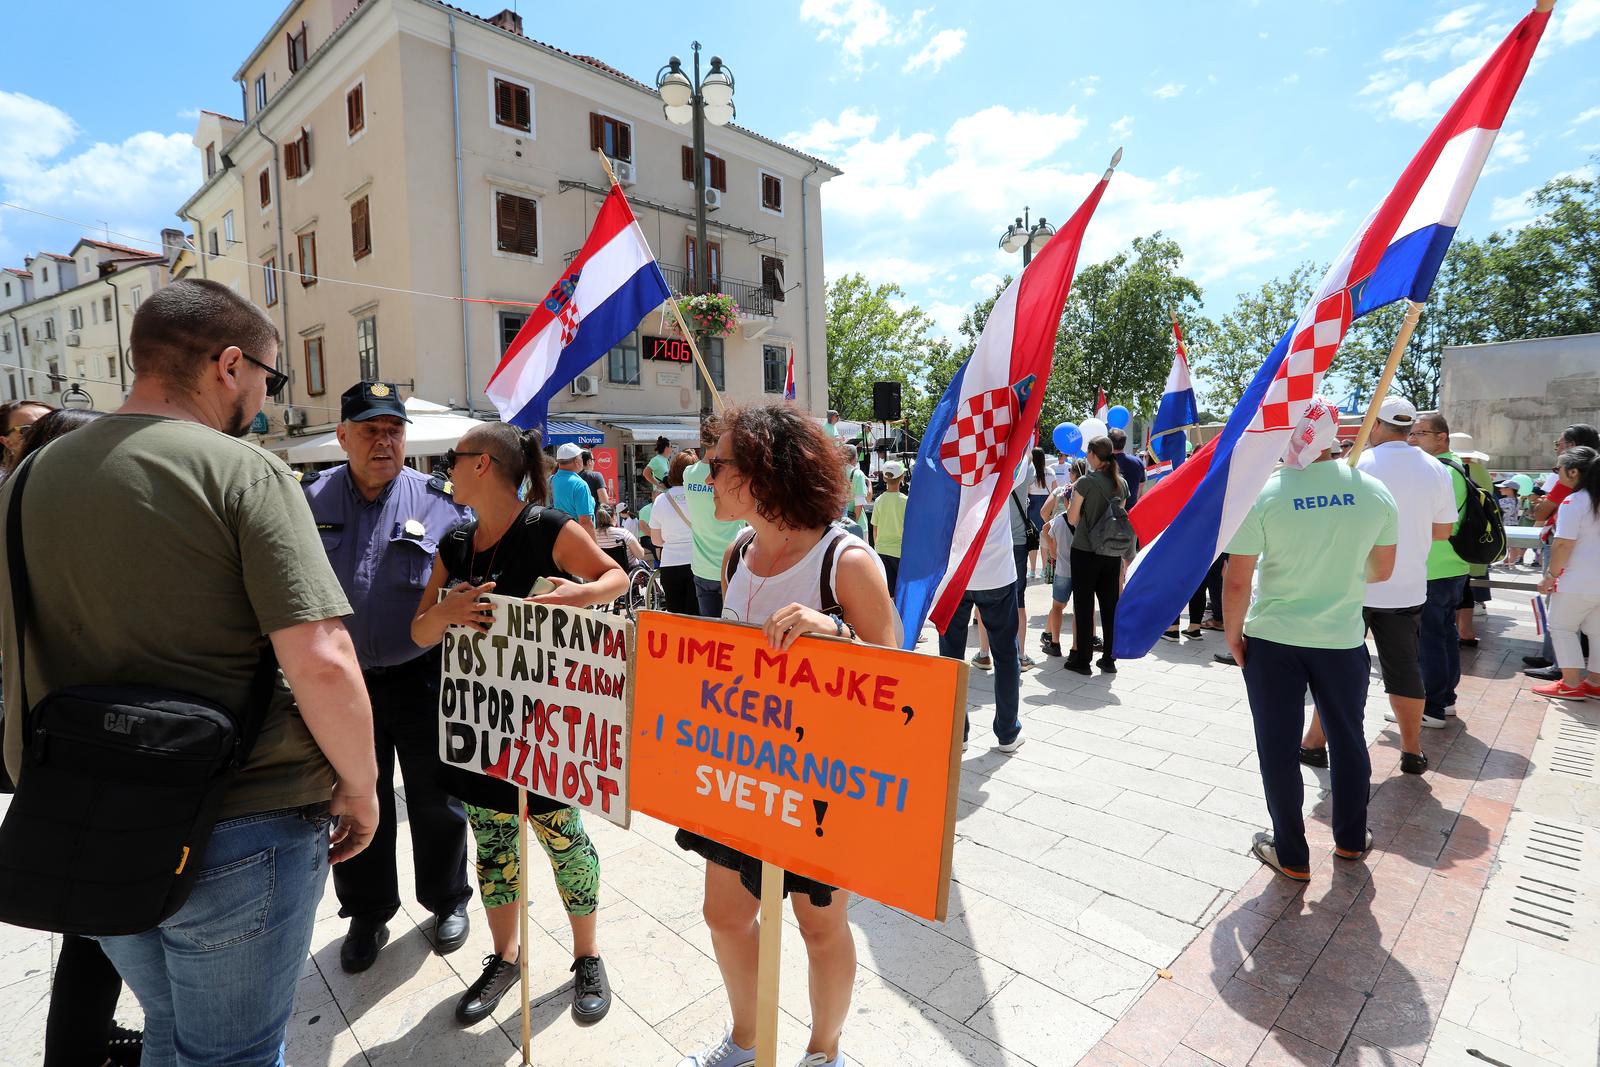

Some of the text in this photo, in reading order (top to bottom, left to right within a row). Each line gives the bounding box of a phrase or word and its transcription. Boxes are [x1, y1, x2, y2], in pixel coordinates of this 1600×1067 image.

[1293, 493, 1356, 511] REDAR
[444, 632, 626, 700] POSTAJE ZAKON
[507, 603, 627, 661] NEPRAVDA
[647, 630, 915, 726] U IME MAJKE,
[701, 674, 804, 743] KĆERI,
[441, 677, 622, 772] OTPOR POSTAJE
[655, 713, 909, 812] I SOLIDARNOSTI
[445, 721, 620, 814] DUŽNOST
